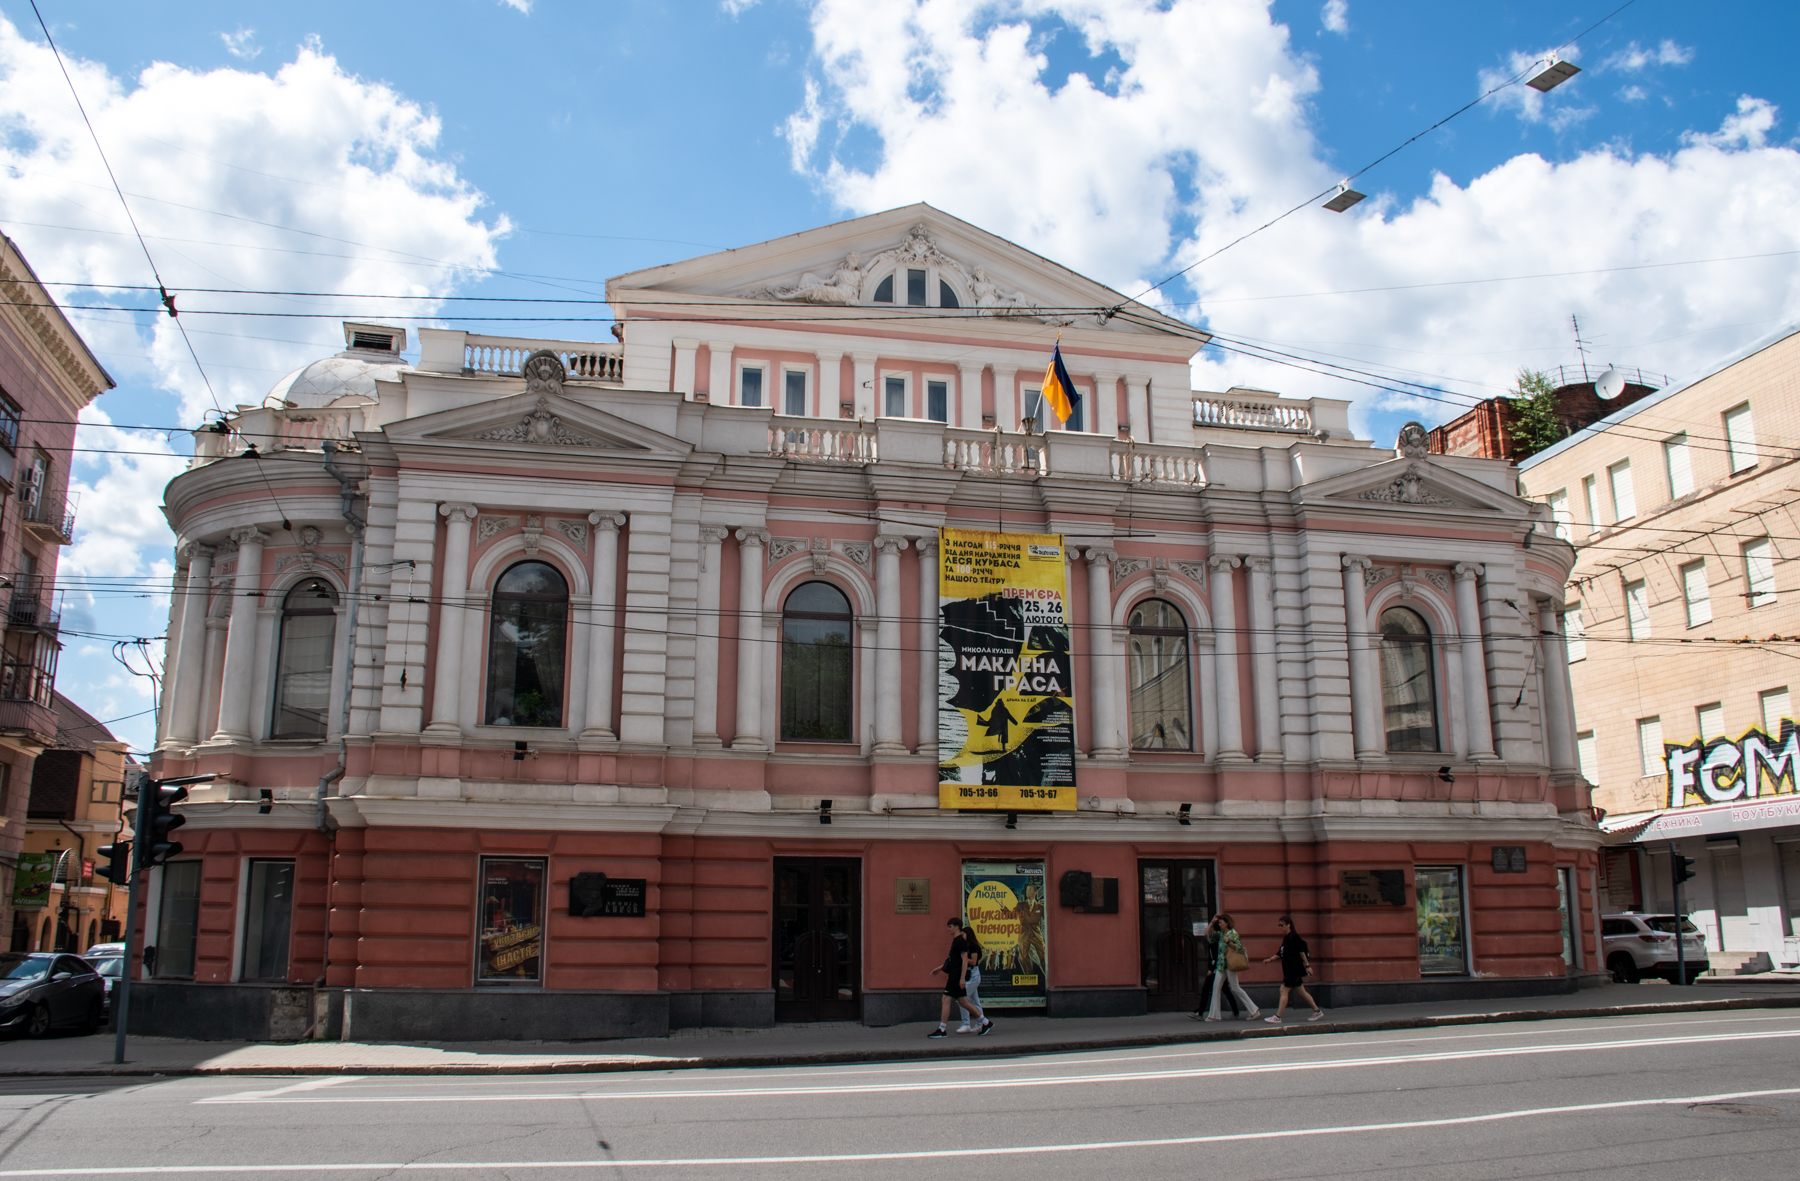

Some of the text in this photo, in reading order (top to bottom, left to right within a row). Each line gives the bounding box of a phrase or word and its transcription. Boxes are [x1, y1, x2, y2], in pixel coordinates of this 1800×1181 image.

[945, 538, 950, 546] З
[953, 540, 983, 549] НАГОДИ
[945, 556, 973, 566] ЛЕСЯ
[975, 558, 1021, 569] КУРБАСА
[945, 565, 954, 573] ТА
[945, 574, 1006, 585] НАШОГО ТЕАТРУ
[1002, 587, 1062, 600] ПРЕМ'ЄРА
[1024, 600, 1063, 614] 25, 26
[1025, 615, 1064, 624] ЛЮТОГО
[961, 646, 991, 654] МИКОЛА
[961, 655, 1061, 674] МАКЛЕНА
[993, 675, 1061, 692] ГРАСА
[959, 787, 1057, 799] 705-13-66 705-13-67
[969, 906, 1025, 924] Шукайте
[976, 923, 1021, 938] тенора
[1014, 976, 1020, 984] 8
